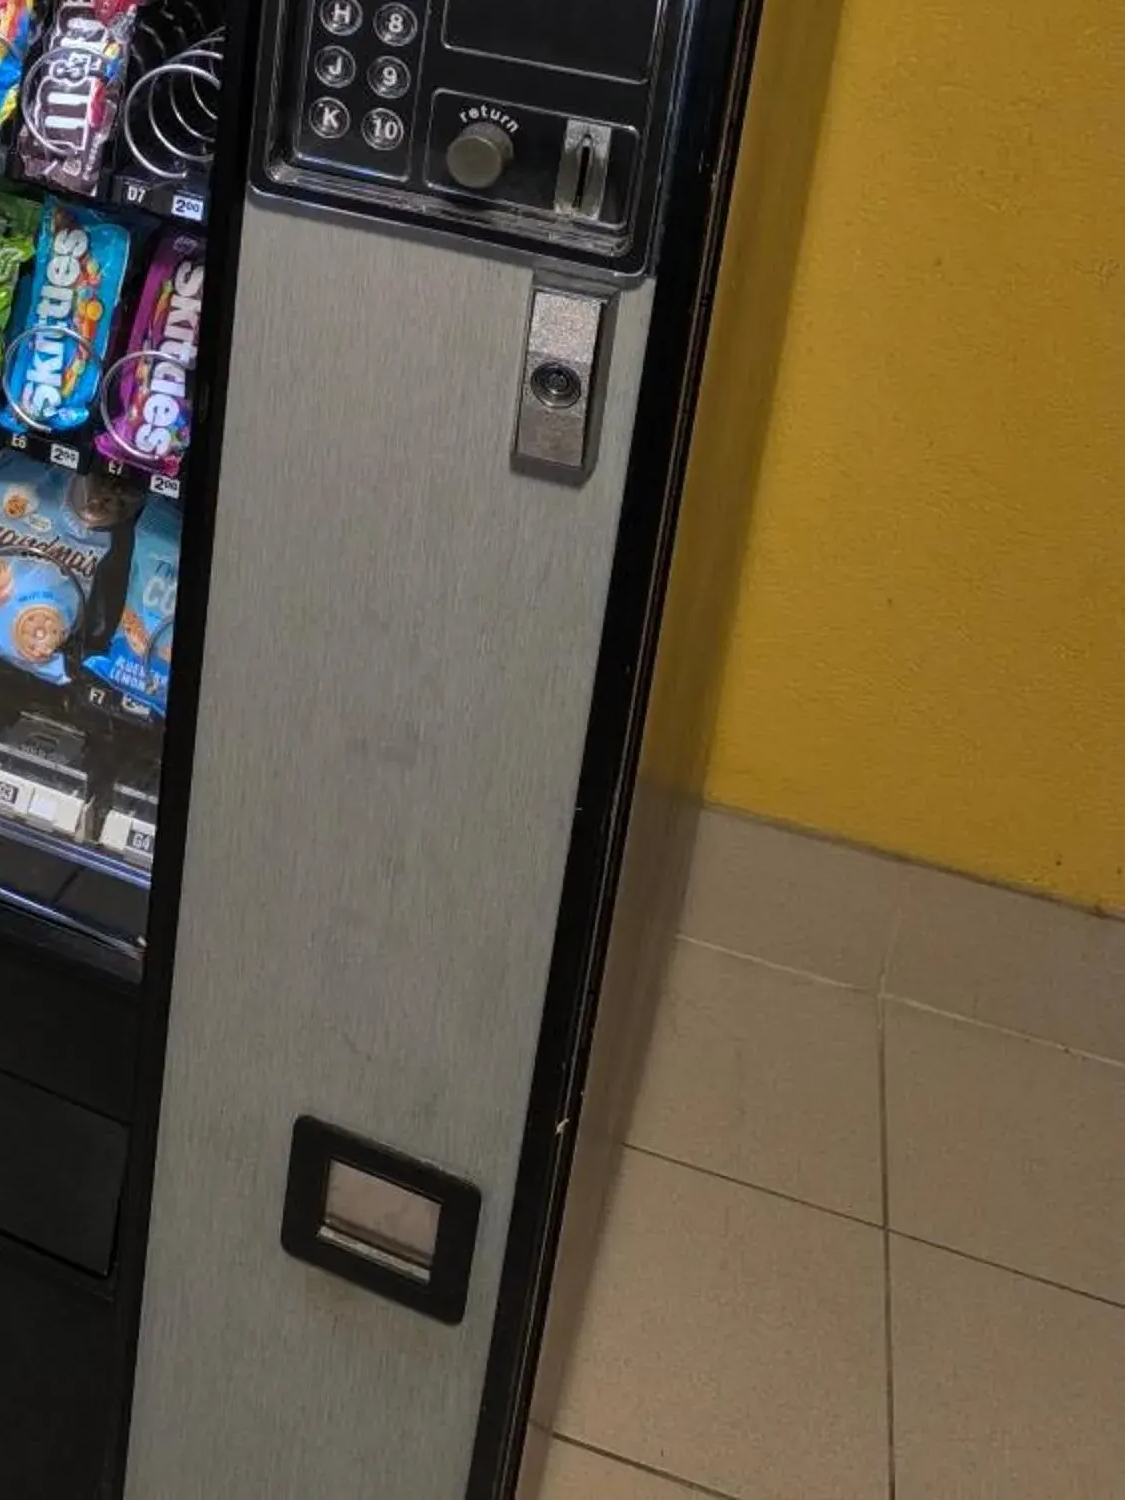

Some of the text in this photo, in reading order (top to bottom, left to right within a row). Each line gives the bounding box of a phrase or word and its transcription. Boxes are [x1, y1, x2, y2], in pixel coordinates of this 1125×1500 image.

[333, 4, 351, 23] H
[389, 13, 403, 34] 8
[328, 58, 342, 76] J
[382, 66, 396, 88] 9
[322, 109, 340, 128] K
[458, 104, 521, 134] return
[374, 118, 398, 139] 10
[127, 187, 146, 203] D7
[89, 690, 105, 705] F7
